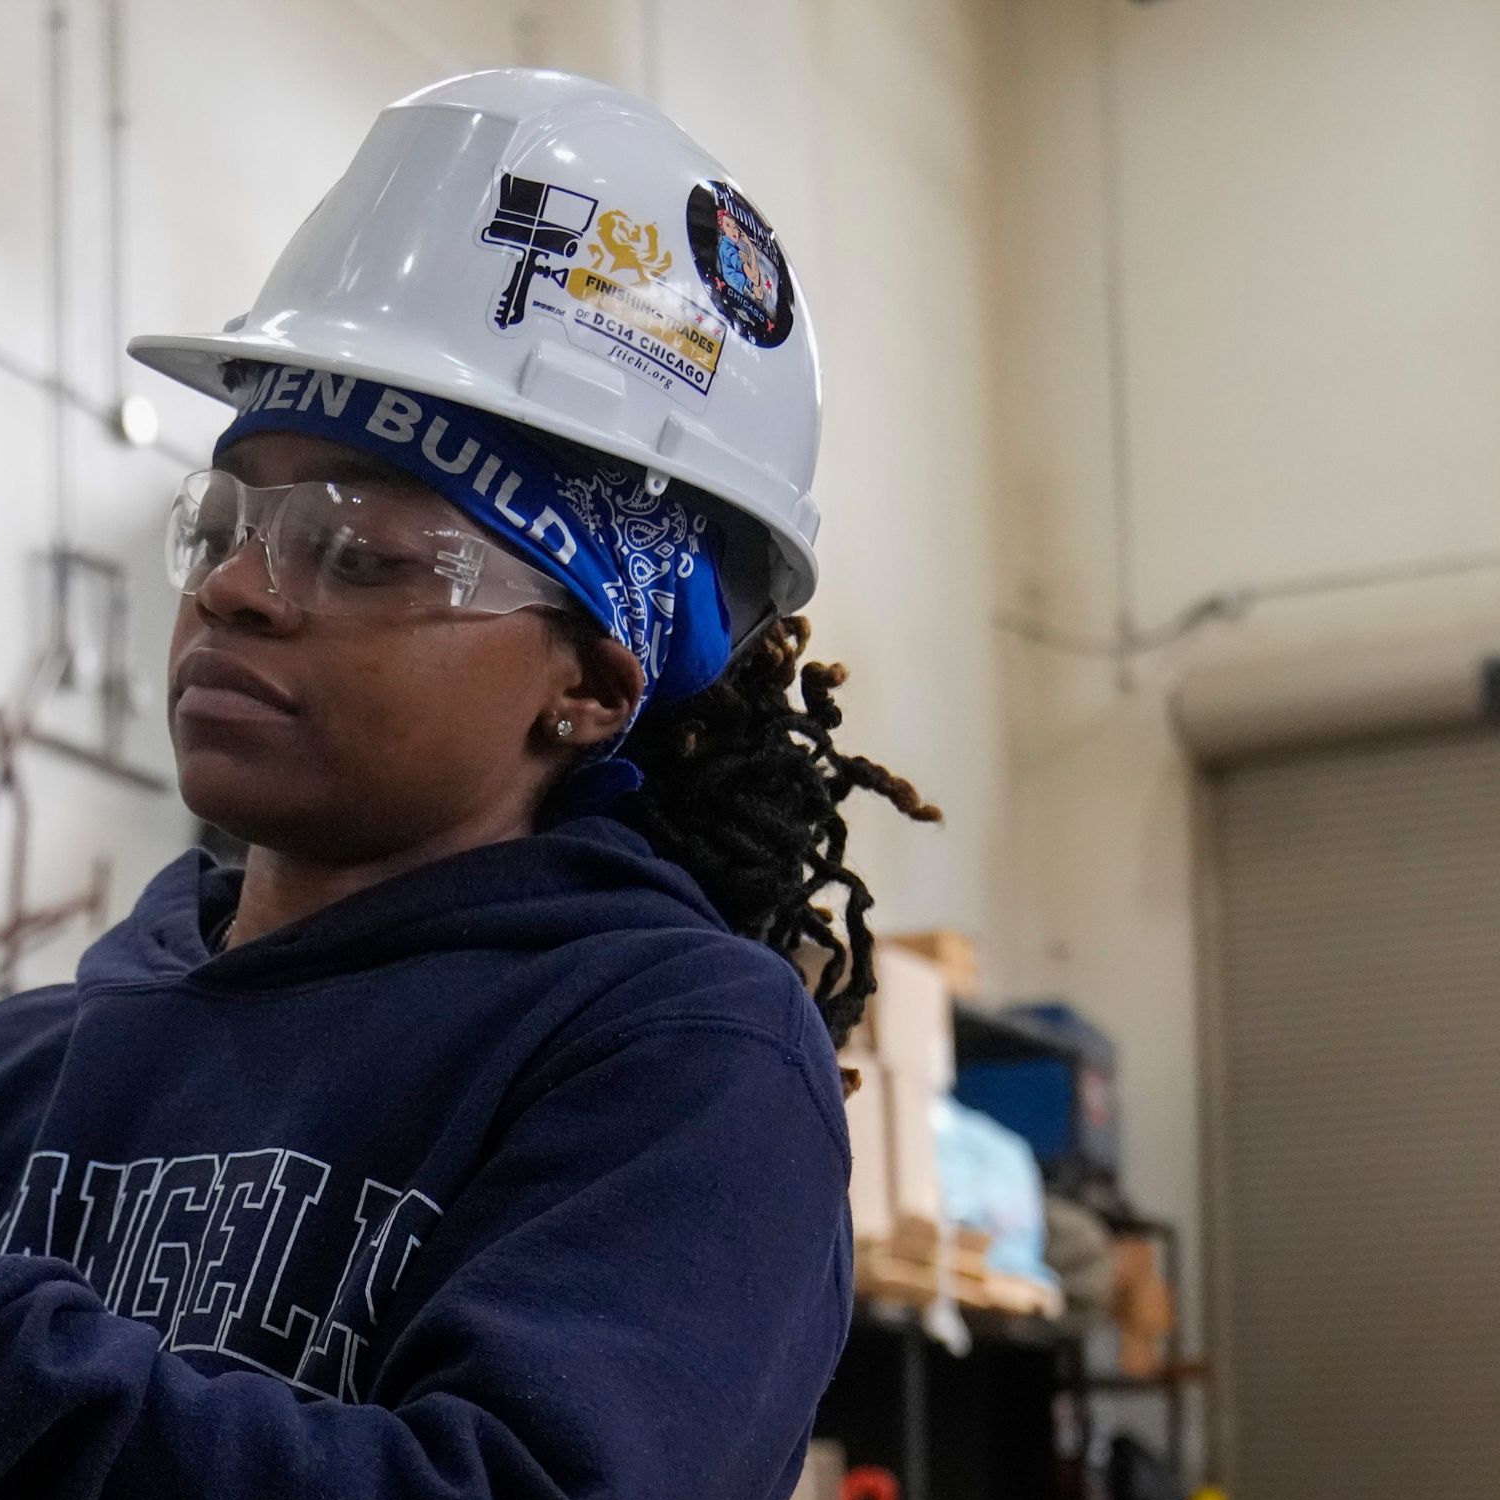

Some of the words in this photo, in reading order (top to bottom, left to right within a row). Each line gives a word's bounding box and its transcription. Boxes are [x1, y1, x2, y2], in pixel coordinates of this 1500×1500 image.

[727, 287, 765, 323] CHICAGO
[593, 312, 634, 341] DC14
[639, 336, 705, 384] CHICAGO
[365, 388, 577, 565] BUILD
